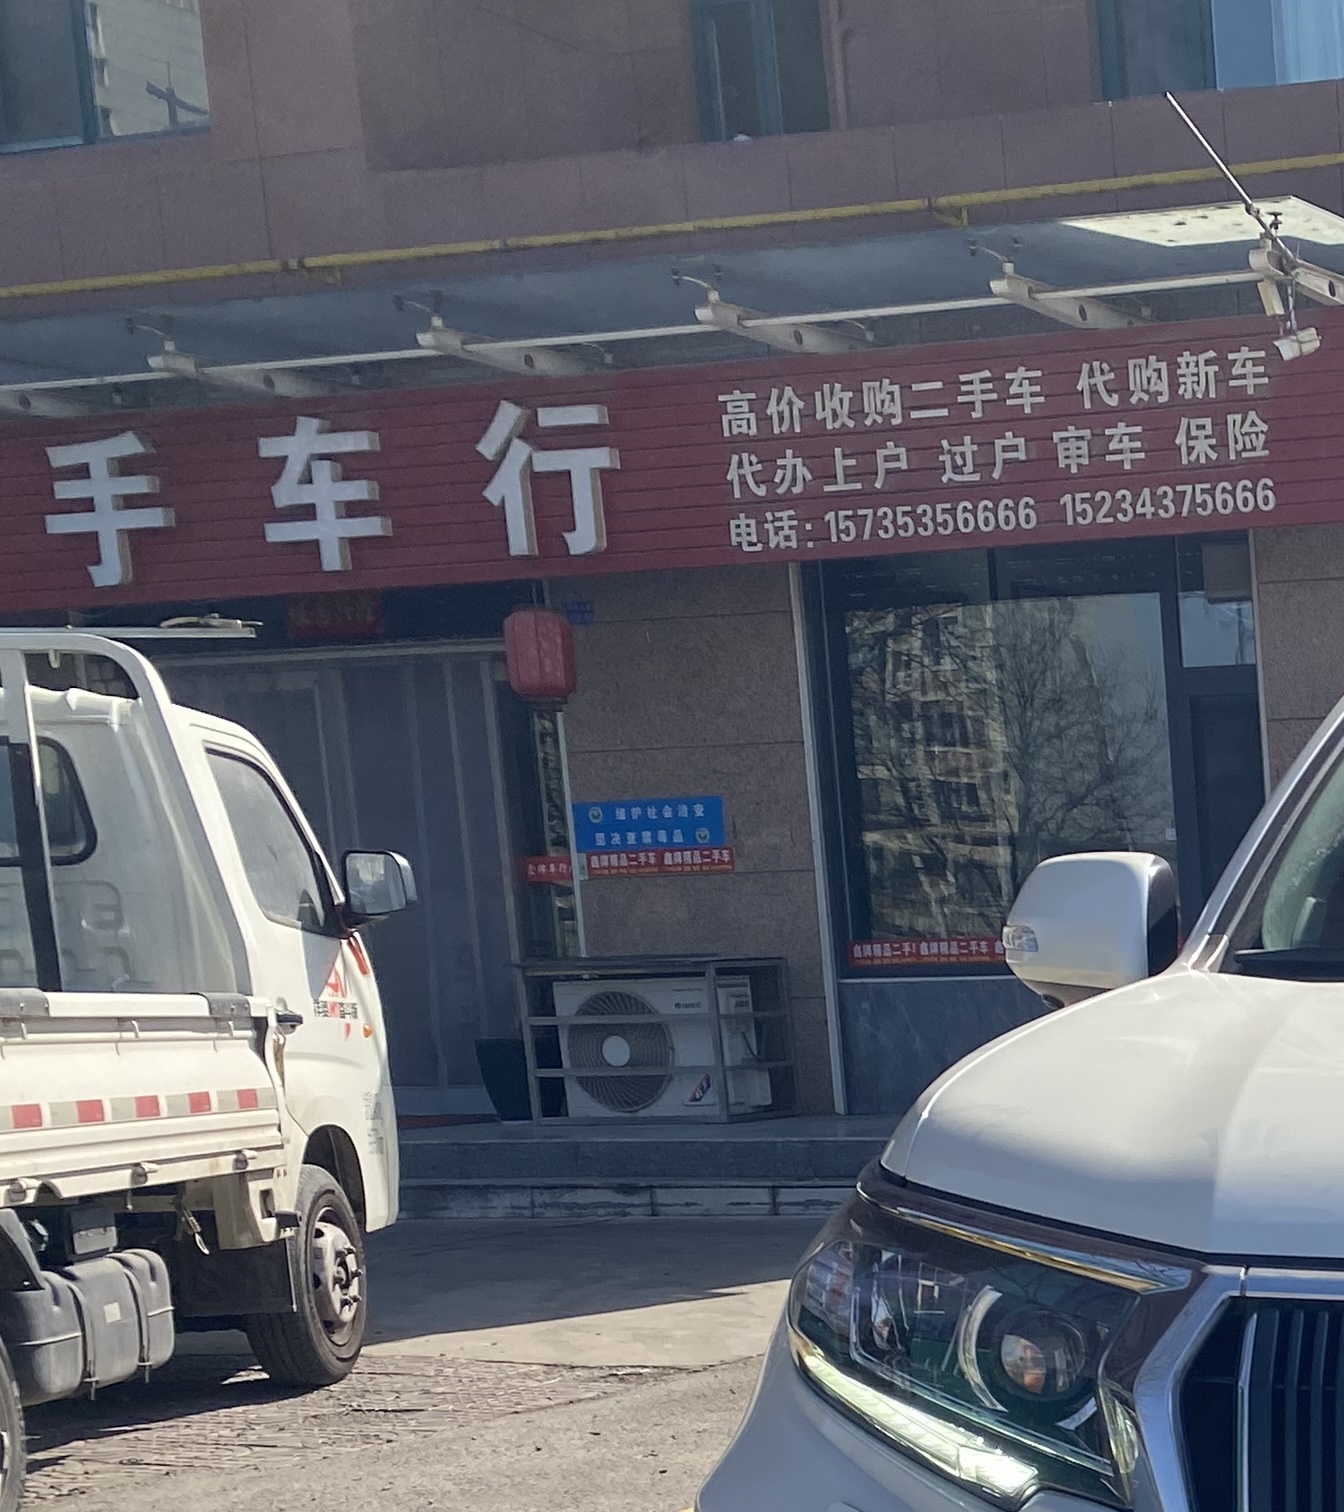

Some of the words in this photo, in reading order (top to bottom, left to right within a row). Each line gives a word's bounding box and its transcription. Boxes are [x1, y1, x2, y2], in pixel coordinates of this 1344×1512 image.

[717, 365, 1046, 438] 高价收购二手车
[1075, 345, 1270, 410] 代购新车
[726, 440, 909, 499] 代办上户
[938, 430, 1028, 485] 过户
[1052, 420, 1146, 475] 审车
[1174, 410, 1271, 465] 保险
[1059, 477, 1277, 527] 15234375666
[615, 803, 704, 820] 维护社会治安
